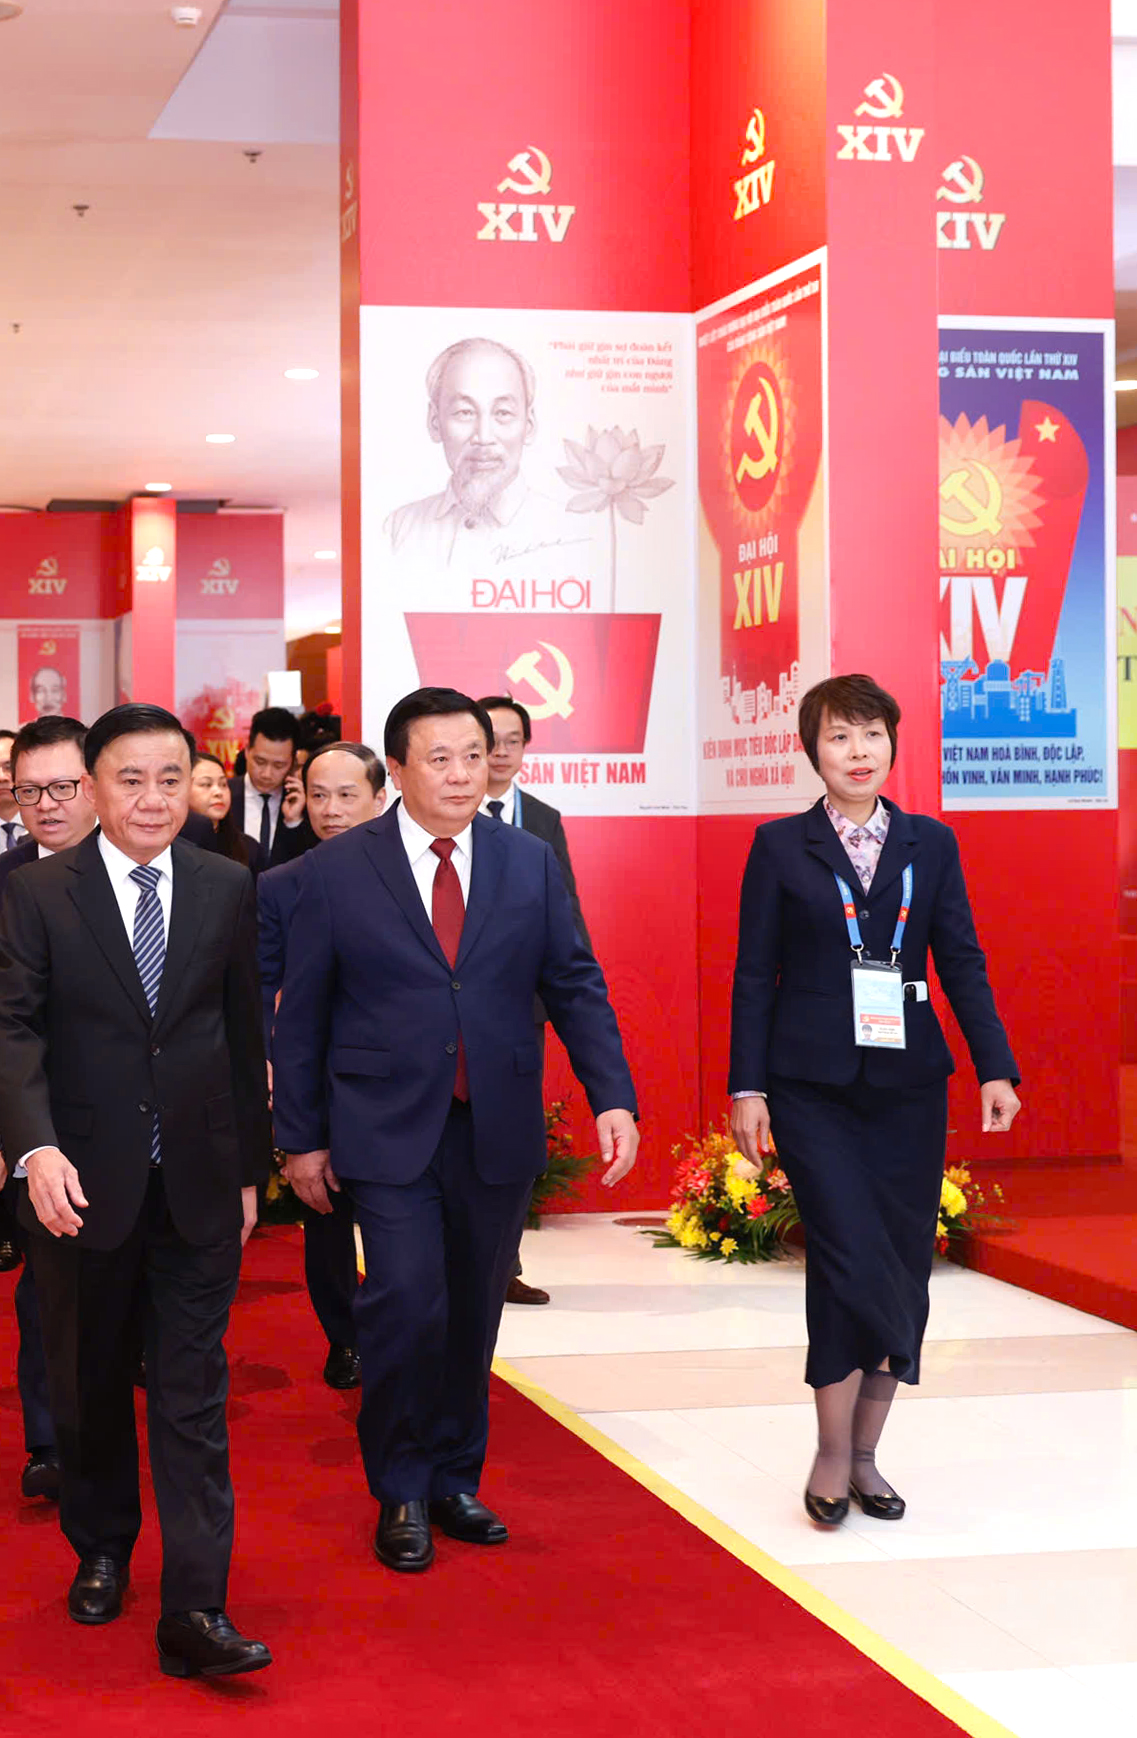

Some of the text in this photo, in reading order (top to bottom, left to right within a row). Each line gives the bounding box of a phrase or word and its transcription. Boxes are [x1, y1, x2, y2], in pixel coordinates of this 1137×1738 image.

[836, 125, 925, 162] XIV
[734, 160, 775, 221] XIV
[477, 202, 576, 243] XIV
[950, 347, 971, 364] BIỂU
[973, 349, 997, 364] TOÀN
[998, 348, 1022, 365] QUỐC
[1062, 353, 1079, 366] XIV
[954, 364, 991, 379] SẢN
[995, 366, 1034, 382] VIỆT
[1038, 368, 1079, 381] NAM
[739, 530, 778, 565] ĐẠI HỘI
[966, 544, 1016, 575] HỘI
[28, 578, 67, 595] XIV
[136, 565, 172, 582] XIV
[201, 579, 240, 595] XIV
[733, 561, 784, 630] XIV
[942, 744, 963, 764] VIỆT
[966, 747, 989, 761] NAM
[1043, 744, 1063, 764] ĐỘC
[1065, 744, 1084, 764] LẬP,
[518, 756, 646, 788] SẢN VIỆT NAM
[962, 770, 988, 785] VINH,
[1013, 770, 1042, 785] MINH,
[1044, 770, 1071, 787] HẠNH
[1073, 766, 1103, 784] PHÚC!
